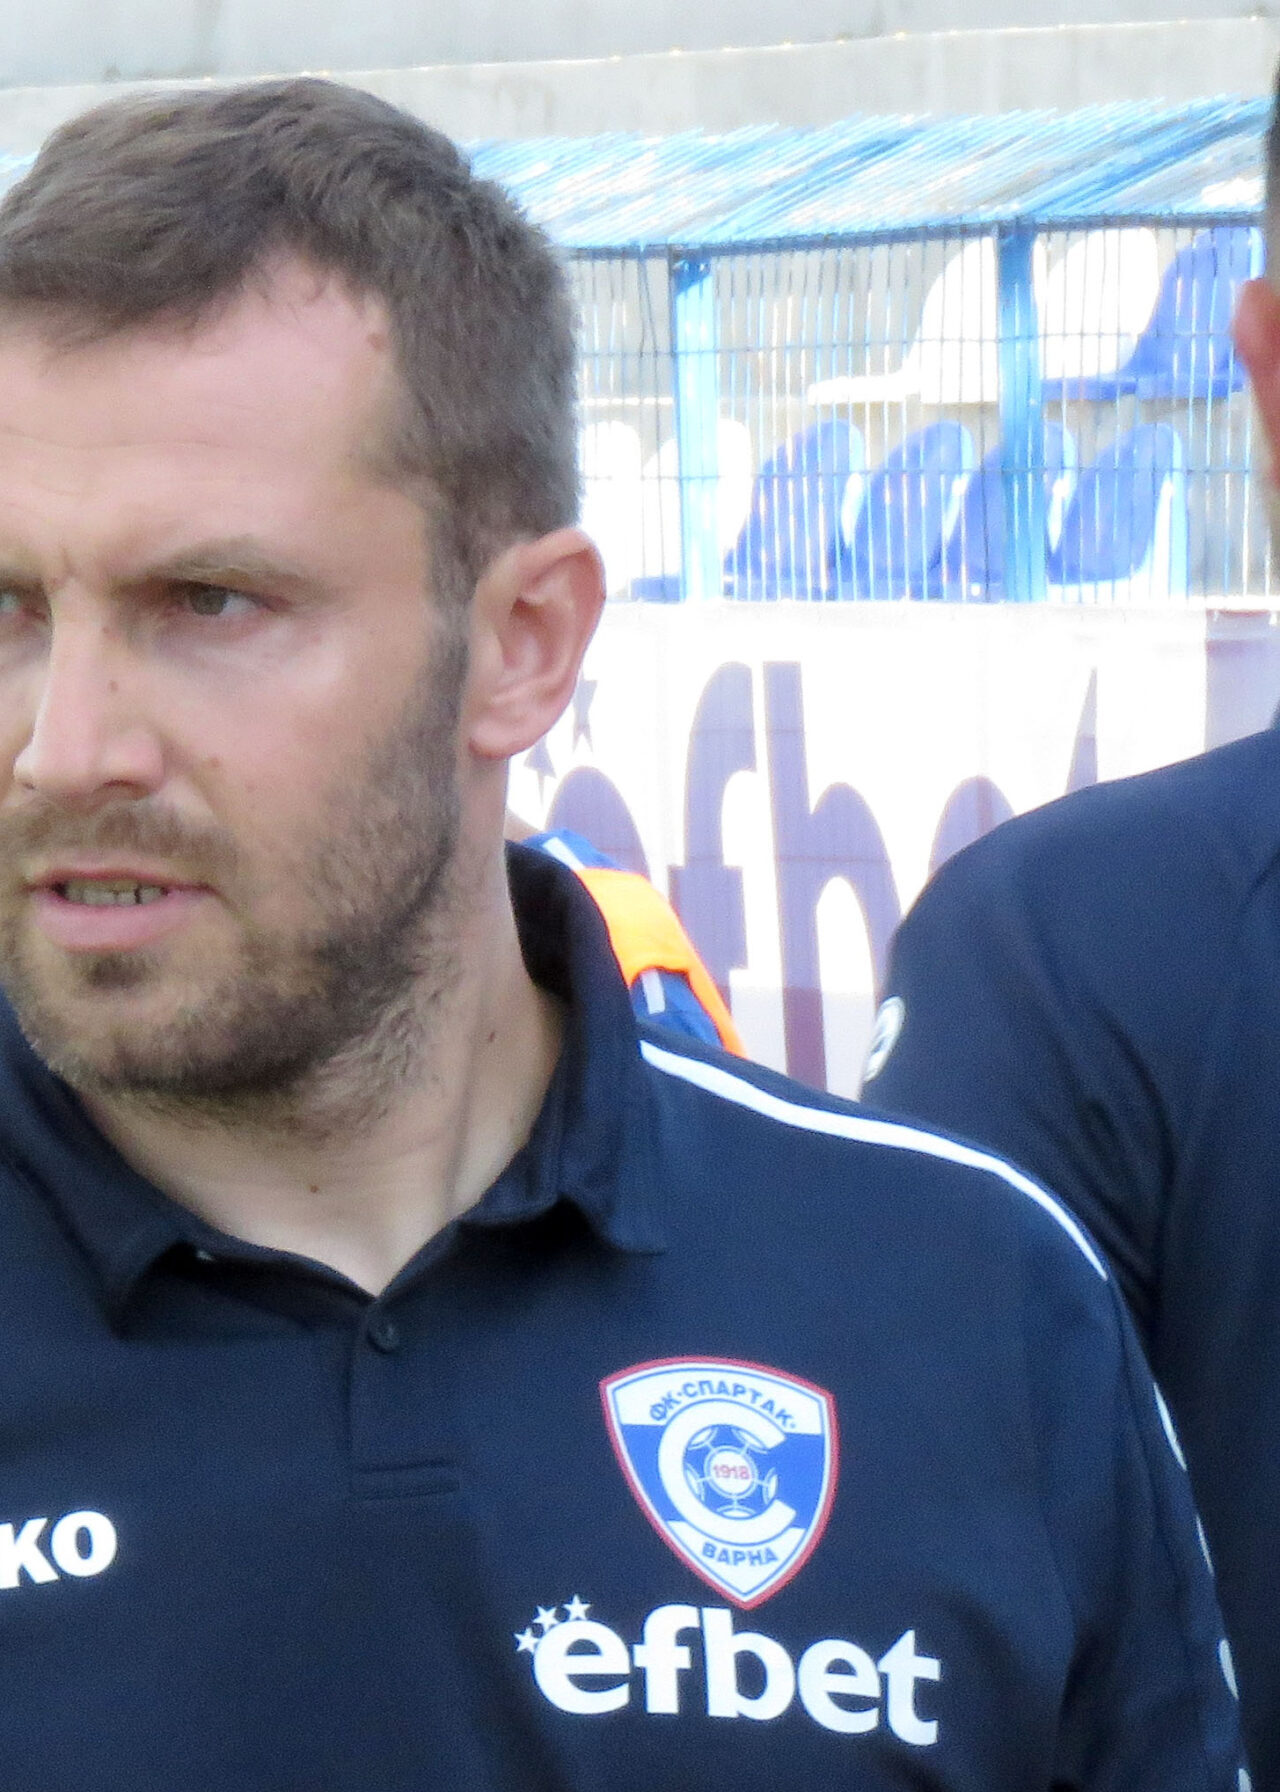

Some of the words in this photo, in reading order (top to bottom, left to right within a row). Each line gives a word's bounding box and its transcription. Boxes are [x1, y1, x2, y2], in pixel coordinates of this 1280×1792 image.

[713, 1465, 751, 1480] 1918
[702, 1542, 779, 1567] ВАРНА
[533, 1605, 941, 1746] efbet
